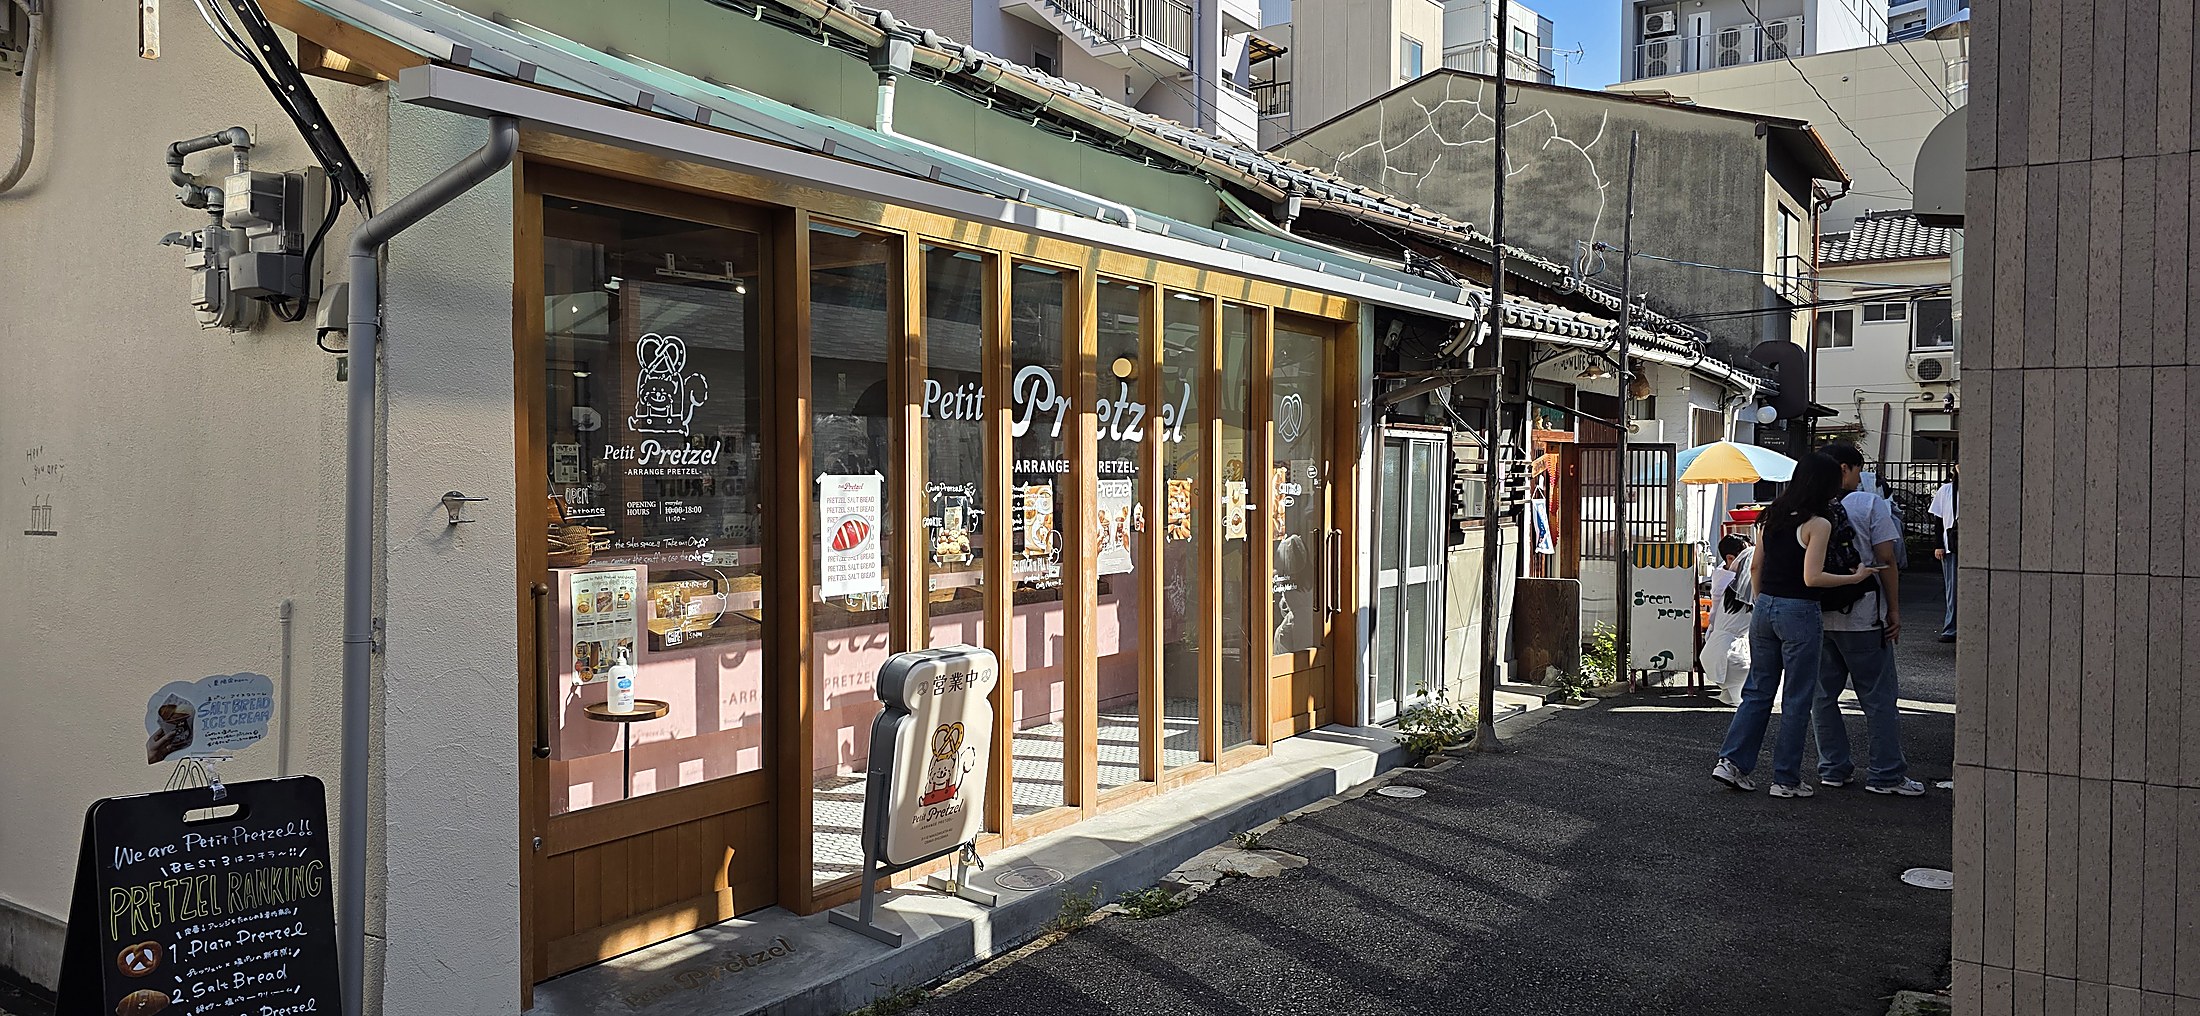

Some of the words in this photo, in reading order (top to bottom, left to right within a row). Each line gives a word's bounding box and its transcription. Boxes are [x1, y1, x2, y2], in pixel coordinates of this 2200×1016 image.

[921, 379, 986, 421] Petit
[1011, 365, 1191, 443] Pretzel
[603, 444, 635, 460] Petit
[637, 439, 721, 465] Pretzel
[624, 468, 664, 476] -ARRANGE
[1011, 459, 1070, 473] -ARRANGE
[1098, 459, 1139, 474] RETZEL-
[564, 487, 590, 505] OPEN
[566, 506, 606, 516] Entrance
[626, 508, 650, 516] HOURS
[827, 564, 847, 572] PRETZEL
[1633, 589, 1672, 606] green
[1657, 608, 1691, 620] pepe
[932, 669, 979, 696] 営業中
[197, 700, 231, 718] SALT
[231, 696, 271, 714] BREAD
[201, 715, 227, 731] ICE
[228, 710, 271, 727] CREAM
[911, 812, 927, 824] Petit
[926, 799, 964, 822] Pretzel
[112, 845, 146, 871] We
[148, 843, 178, 857] are
[182, 832, 229, 853] Petit
[231, 819, 314, 846] Pretzel!!
[109, 873, 223, 941] PRETZEL
[227, 859, 324, 914] RANKING
[168, 942, 189, 964] 1.
[187, 938, 232, 958] Plain
[236, 921, 308, 945] Pretzel
[673, 935, 797, 991] Pretzel
[171, 989, 190, 1004] 2.
[192, 978, 229, 998] Salt
[232, 963, 288, 989] Bread
